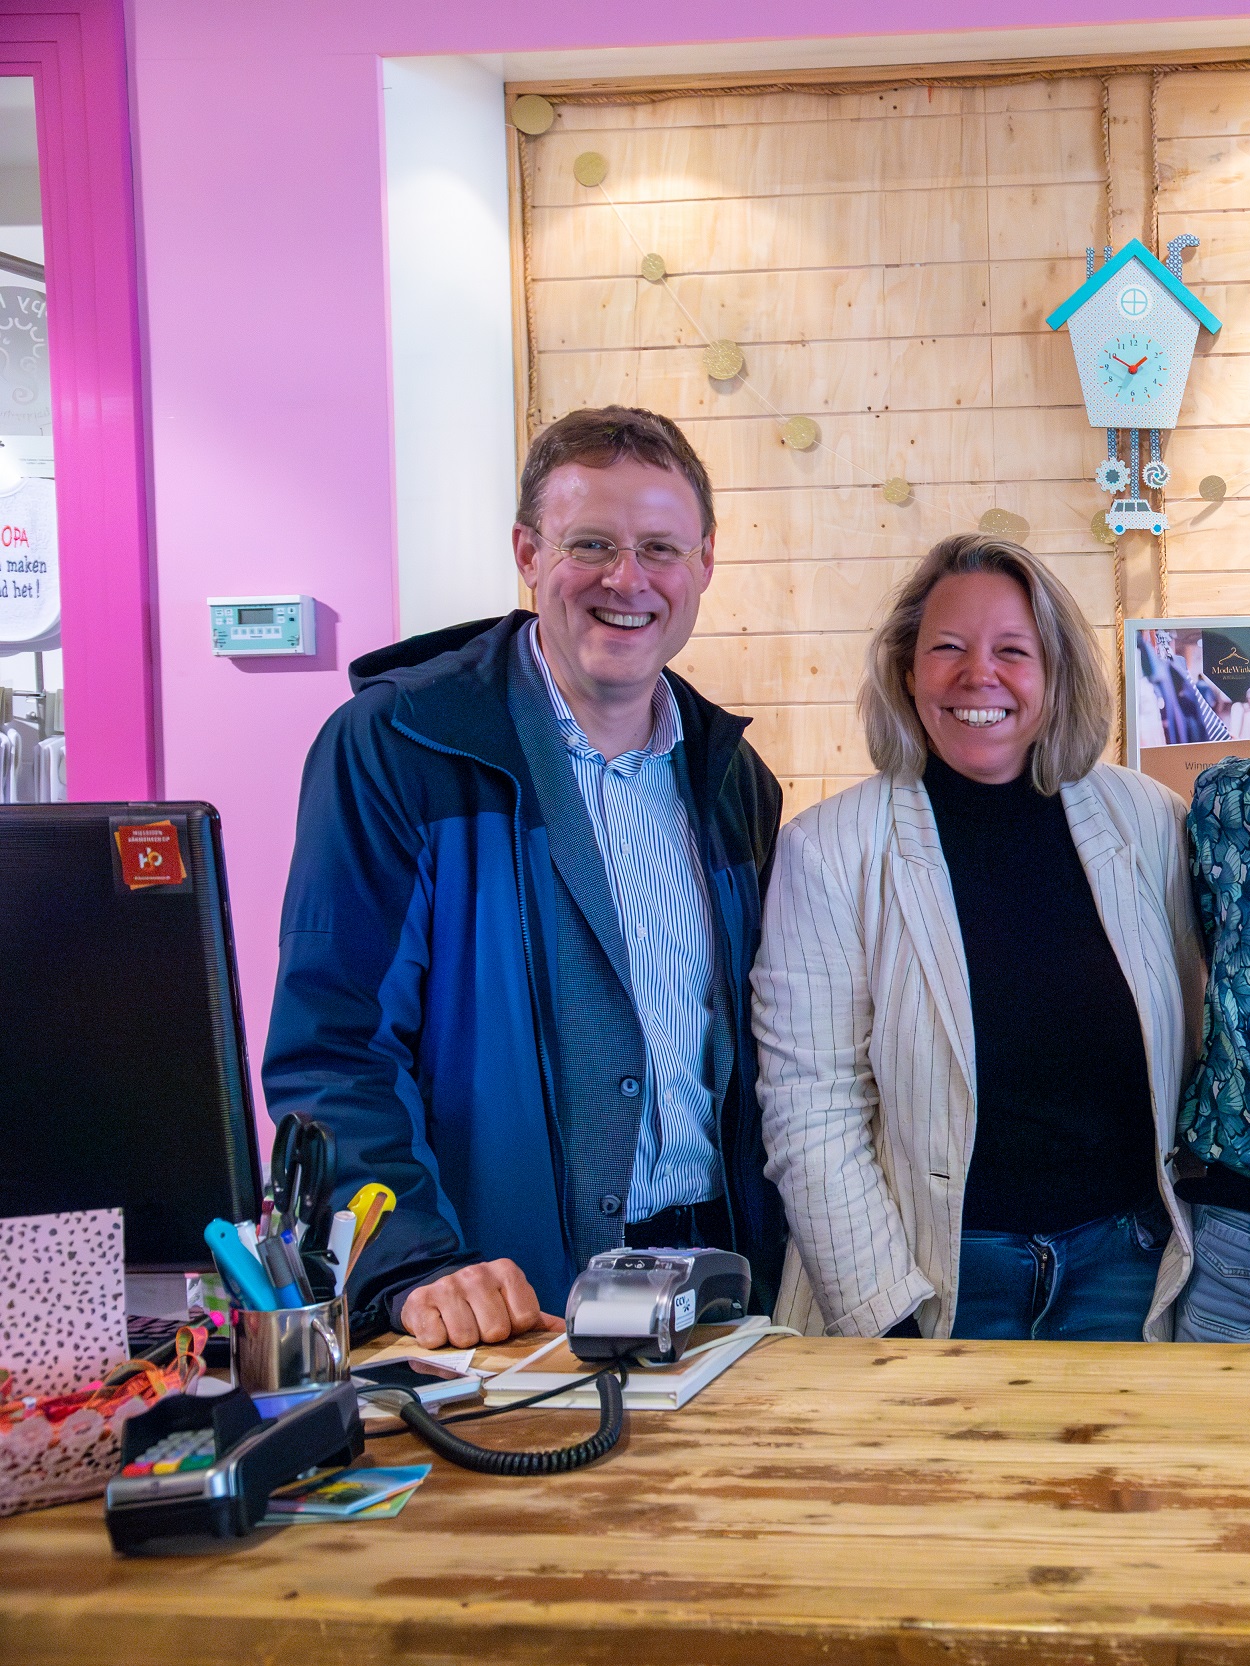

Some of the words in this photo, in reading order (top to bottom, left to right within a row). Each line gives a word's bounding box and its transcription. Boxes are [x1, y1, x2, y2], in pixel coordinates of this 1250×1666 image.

[1129, 339, 1138, 347] 12
[1104, 363, 1110, 371] 9
[1108, 375, 1114, 383] 8
[1117, 385, 1123, 393] 7
[1130, 389, 1136, 397] 6
[1143, 386, 1149, 394] 5
[1, 525, 30, 548] OPA
[6, 555, 47, 574] maken
[12, 579, 40, 599] het!
